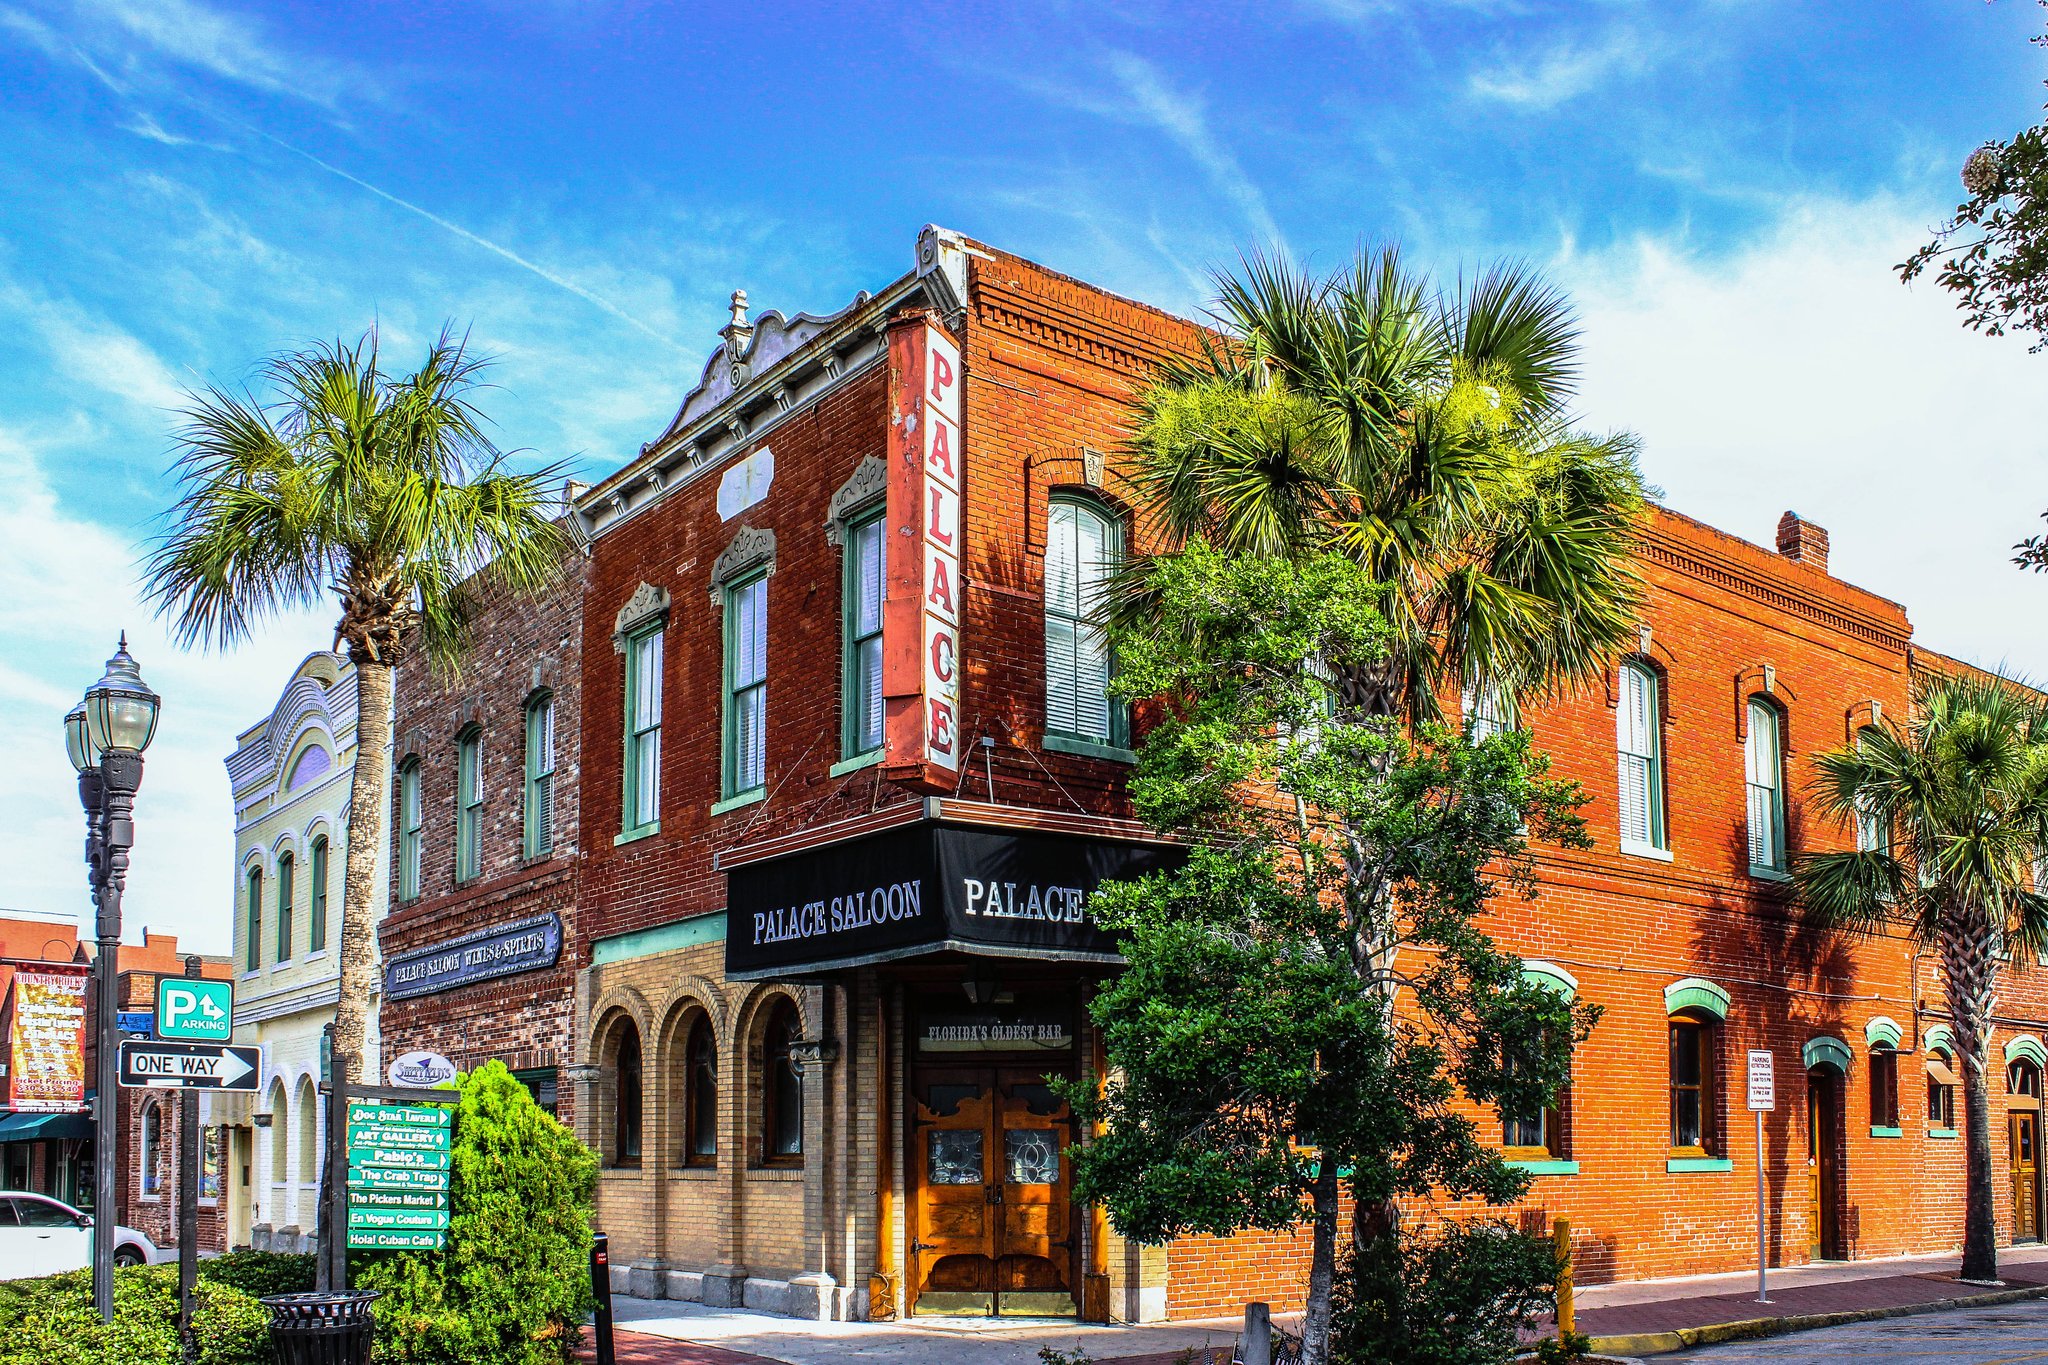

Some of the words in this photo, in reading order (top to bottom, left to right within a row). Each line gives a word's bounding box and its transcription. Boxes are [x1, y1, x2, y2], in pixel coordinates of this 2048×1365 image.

[928, 347, 955, 756] PALACE
[963, 878, 1083, 923] PALACE
[753, 899, 827, 945] PALACE
[831, 879, 921, 932] SALOON
[395, 963, 426, 983] PALACE
[427, 953, 461, 976] SALOON
[464, 943, 494, 966] WINES
[504, 931, 545, 956] SPIRITS
[929, 1025, 988, 1041] FLORIDA'S
[991, 1025, 1034, 1041] OLDEST
[1038, 1024, 1062, 1040] BAR
[136, 1055, 174, 1073] ONE
[181, 1057, 219, 1075] WAY
[15, 1077, 42, 1085] Ticket
[378, 1110, 402, 1122] STAR
[397, 1108, 437, 1123] TAVERN
[355, 1131, 380, 1140] ART
[382, 1132, 435, 1143] GALLERY
[374, 1150, 424, 1163] Pablo's
[360, 1169, 381, 1180] The
[383, 1170, 410, 1181] Crab
[413, 1171, 438, 1183] Trap
[350, 1192, 368, 1203] The
[369, 1193, 402, 1204] Pickers
[403, 1194, 433, 1205] Market
[351, 1213, 364, 1223] En
[365, 1214, 395, 1226] Vogue
[396, 1214, 433, 1225] Couture
[350, 1234, 376, 1244] Hola!
[378, 1234, 410, 1245] Cuban
[412, 1235, 434, 1246] Cafe
